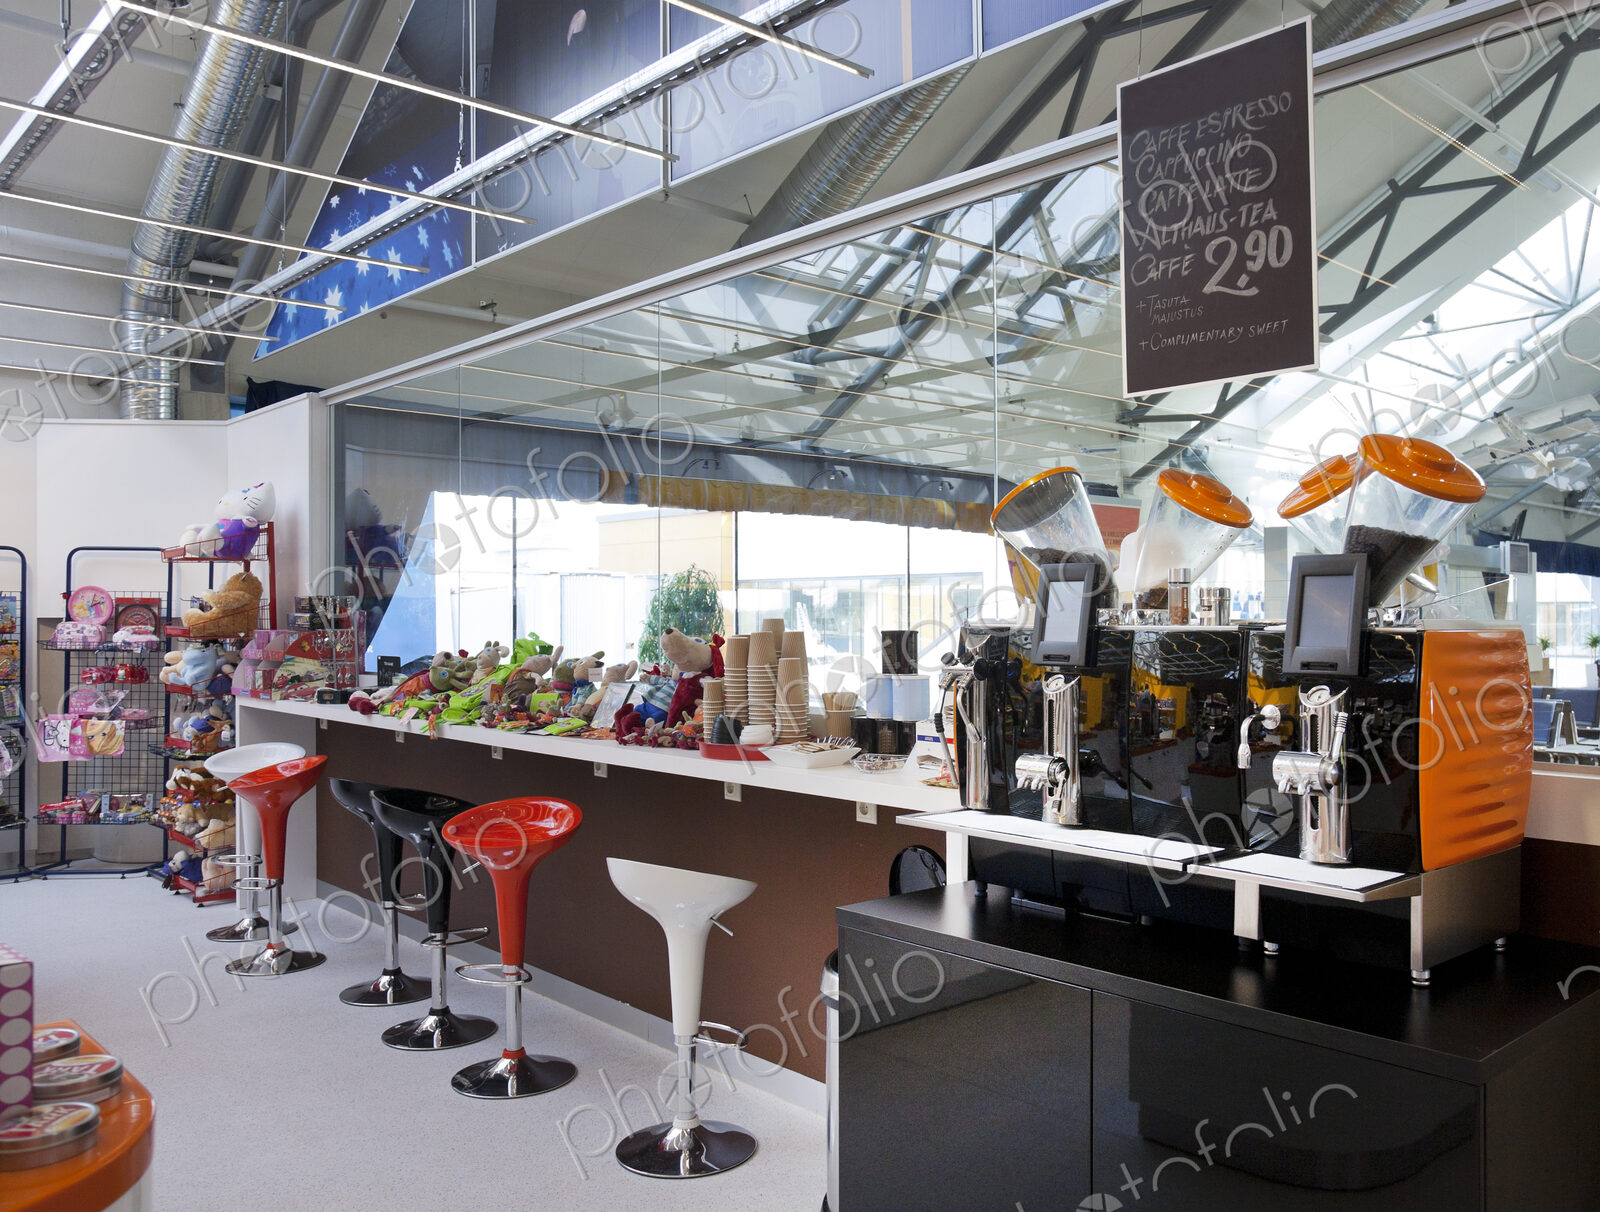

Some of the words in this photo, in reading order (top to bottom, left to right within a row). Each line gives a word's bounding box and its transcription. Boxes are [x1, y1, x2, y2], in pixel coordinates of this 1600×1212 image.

[1196, 91, 1292, 138] ESPRESSO
[1202, 225, 1293, 296] 2.90
[1248, 319, 1289, 338] SWEET
